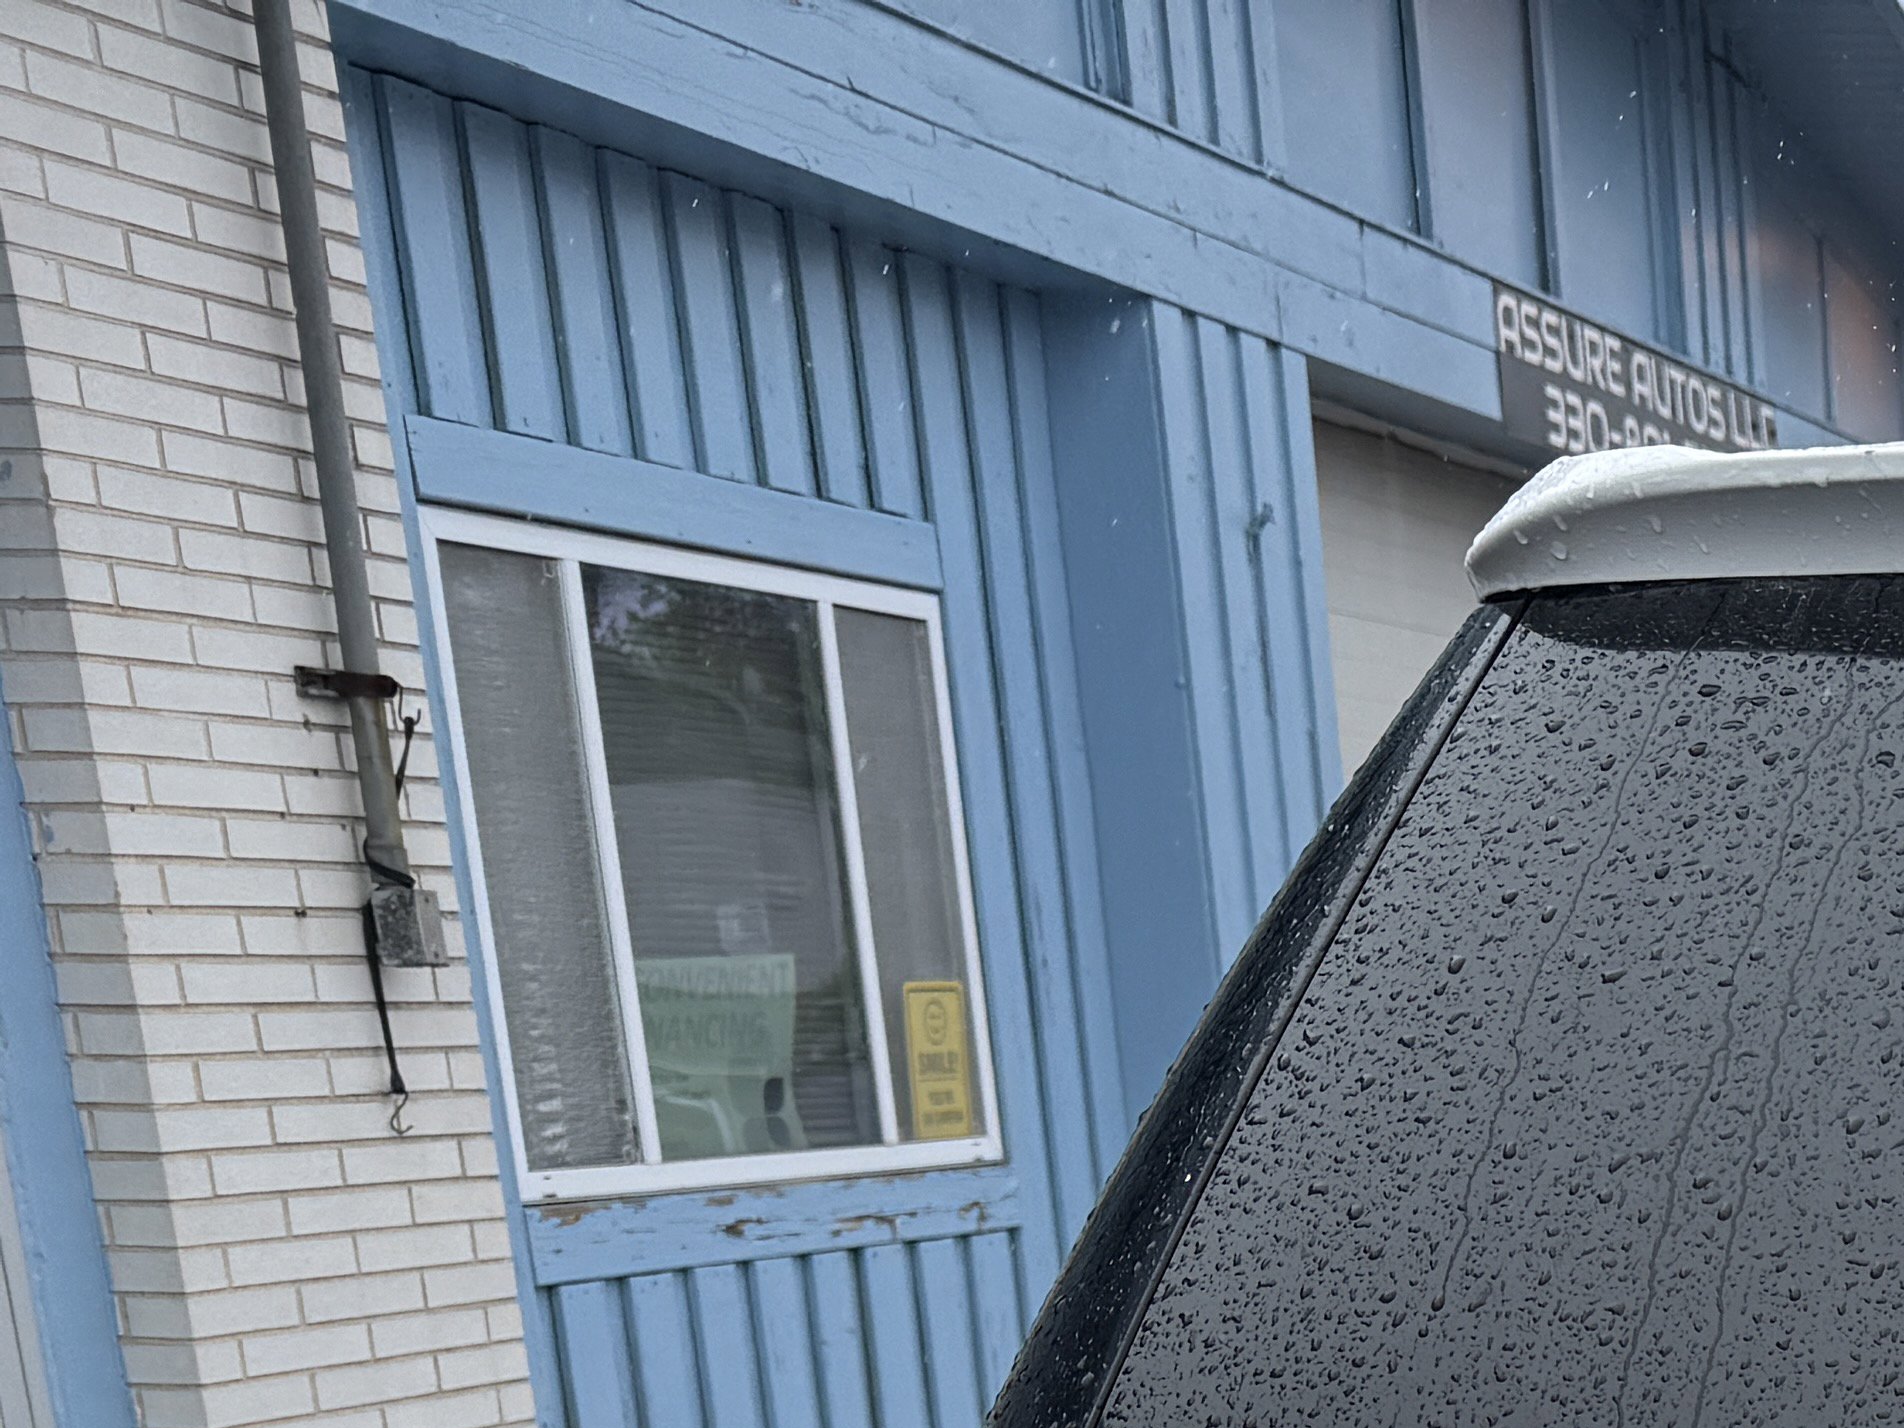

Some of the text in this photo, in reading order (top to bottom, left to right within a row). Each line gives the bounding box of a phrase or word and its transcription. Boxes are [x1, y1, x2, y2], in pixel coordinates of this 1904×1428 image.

[1497, 294, 1779, 450] ASSURE AUTOS LLC
